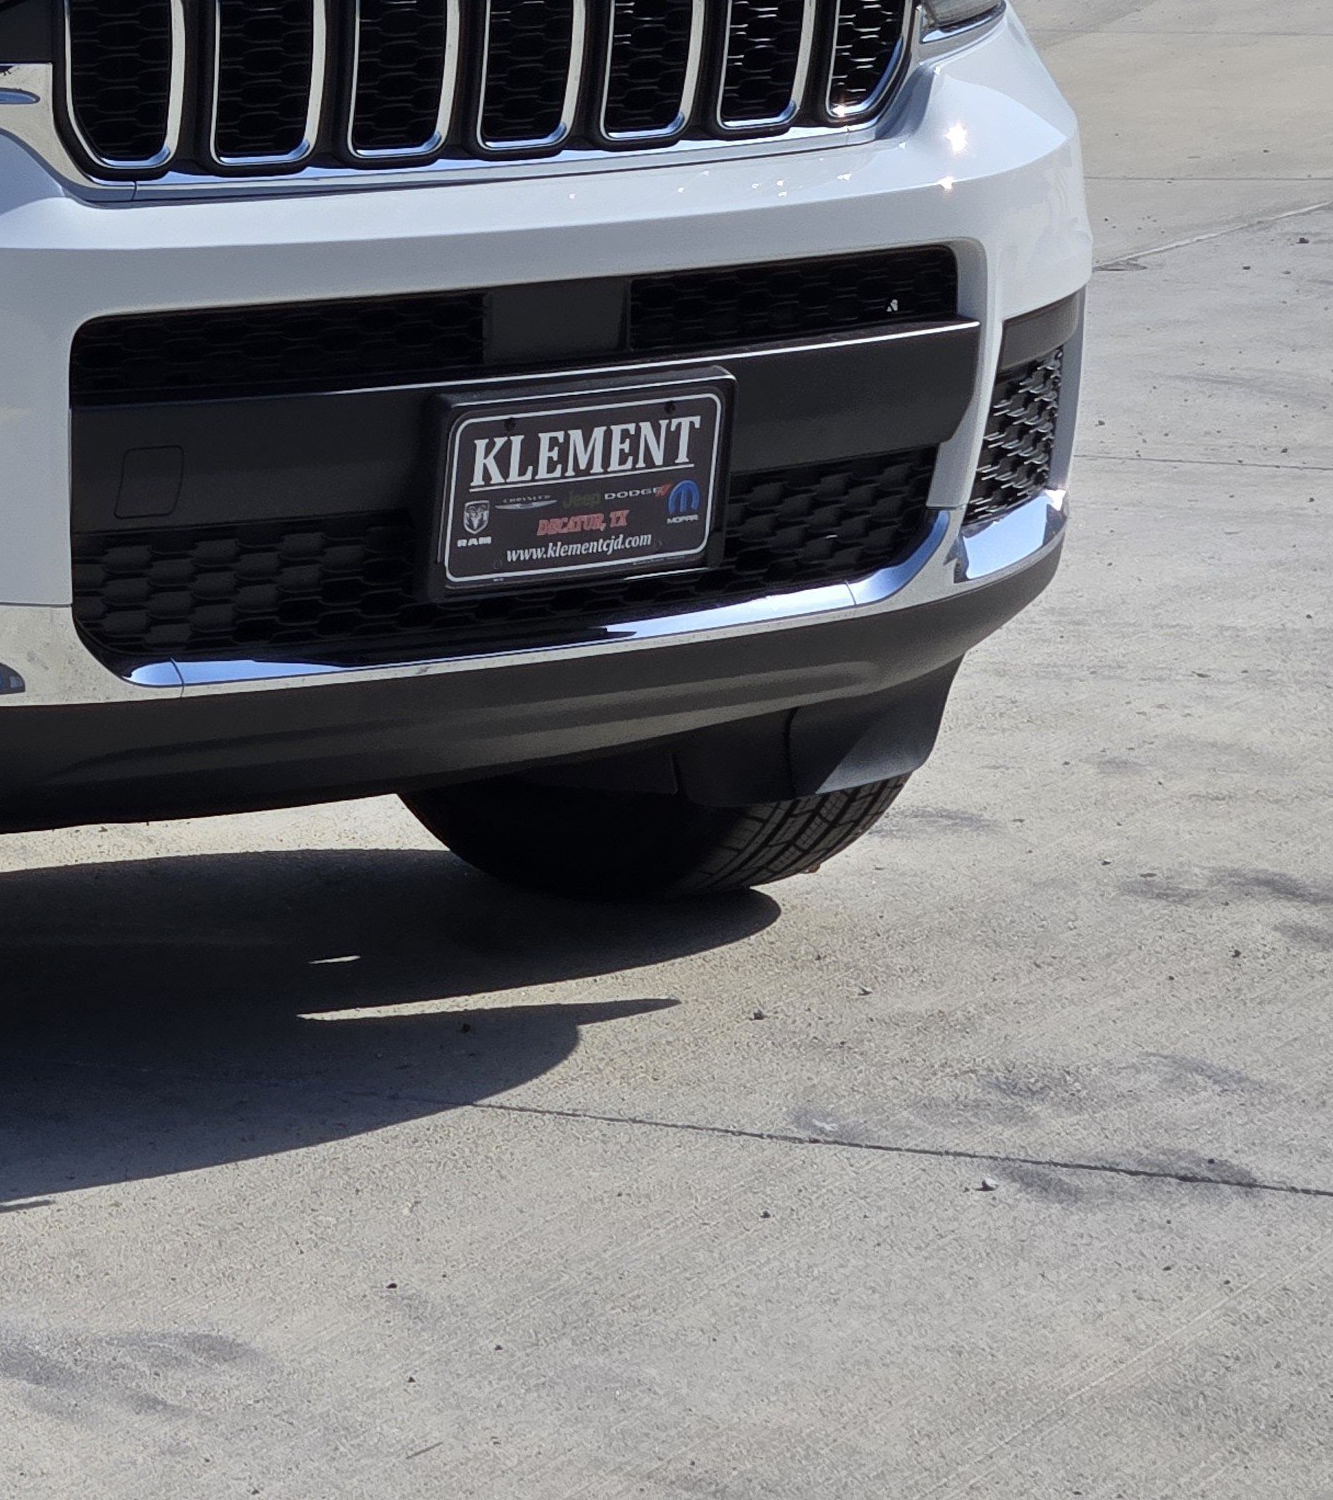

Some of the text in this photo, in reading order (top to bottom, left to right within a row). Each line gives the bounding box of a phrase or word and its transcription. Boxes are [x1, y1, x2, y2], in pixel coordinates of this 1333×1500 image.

[470, 415, 701, 486] KLEMENT
[562, 490, 602, 510] Jeep
[604, 486, 663, 500] DODGE
[536, 509, 630, 536] DECATUR, TX
[456, 536, 492, 548] RAM
[506, 533, 652, 562] www.klementcjd.com
